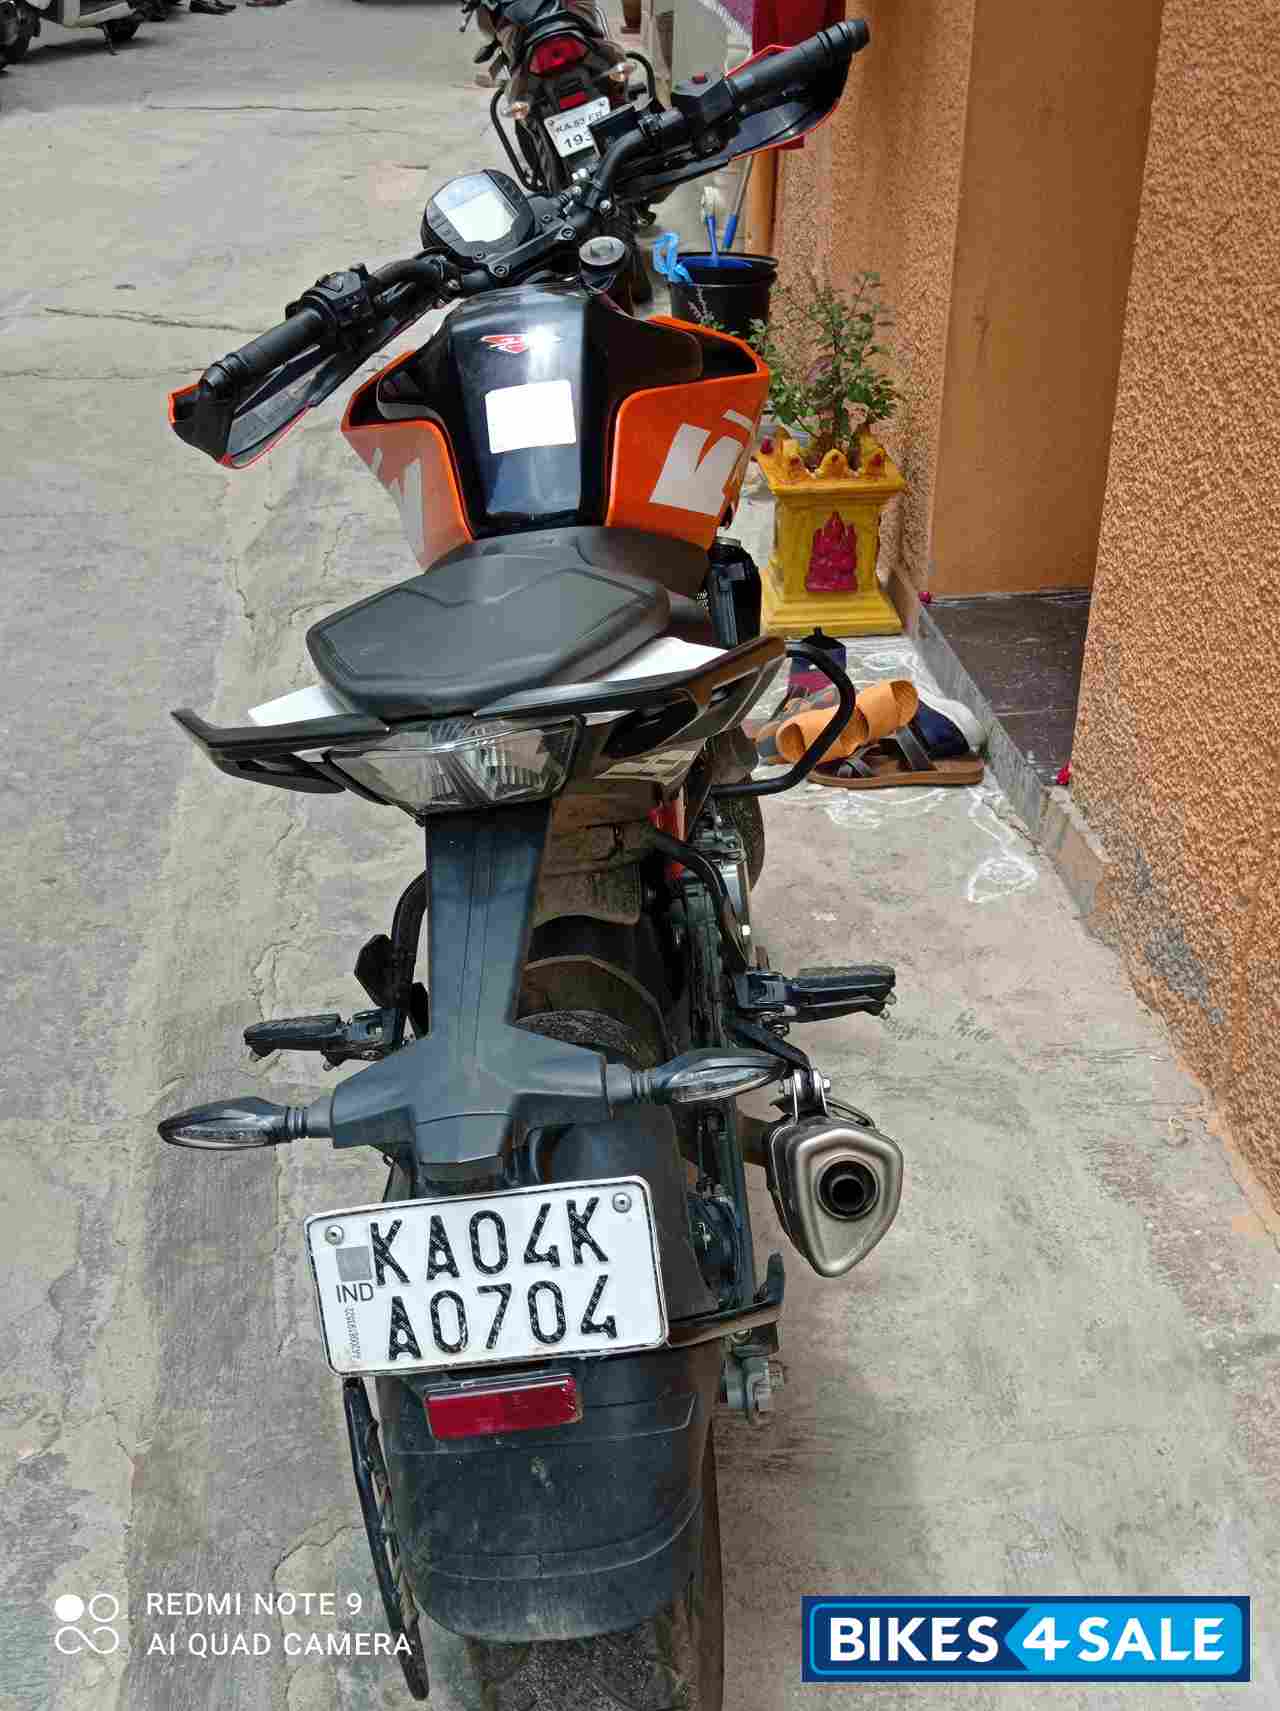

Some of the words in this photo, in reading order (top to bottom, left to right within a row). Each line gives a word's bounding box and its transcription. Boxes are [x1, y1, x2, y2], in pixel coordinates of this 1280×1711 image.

[370, 1197, 609, 1286] KA04K
[336, 1283, 374, 1303] IND
[388, 1275, 618, 1360] A0704
